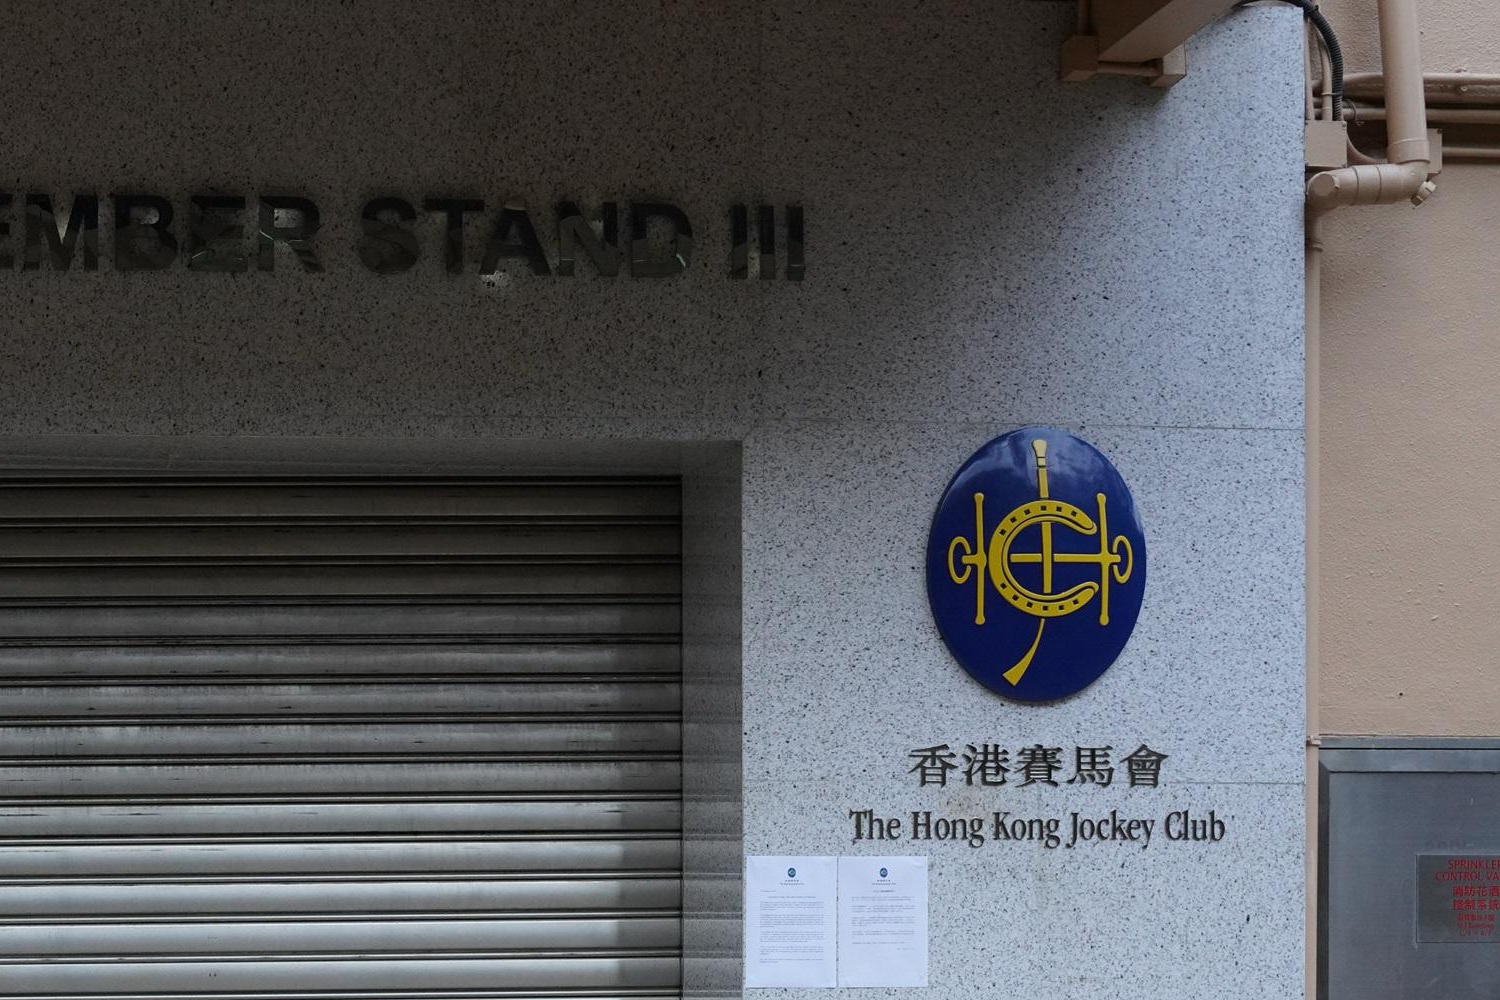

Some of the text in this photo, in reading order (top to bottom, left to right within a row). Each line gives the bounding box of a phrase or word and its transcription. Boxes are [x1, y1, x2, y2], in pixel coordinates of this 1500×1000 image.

[359, 195, 693, 279] STAND
[731, 203, 804, 281] III
[907, 743, 1169, 789] 香港賽馬會
[849, 808, 1226, 849] The Hong Kong Jockey Club
[1435, 871, 1481, 881] CONTROL
